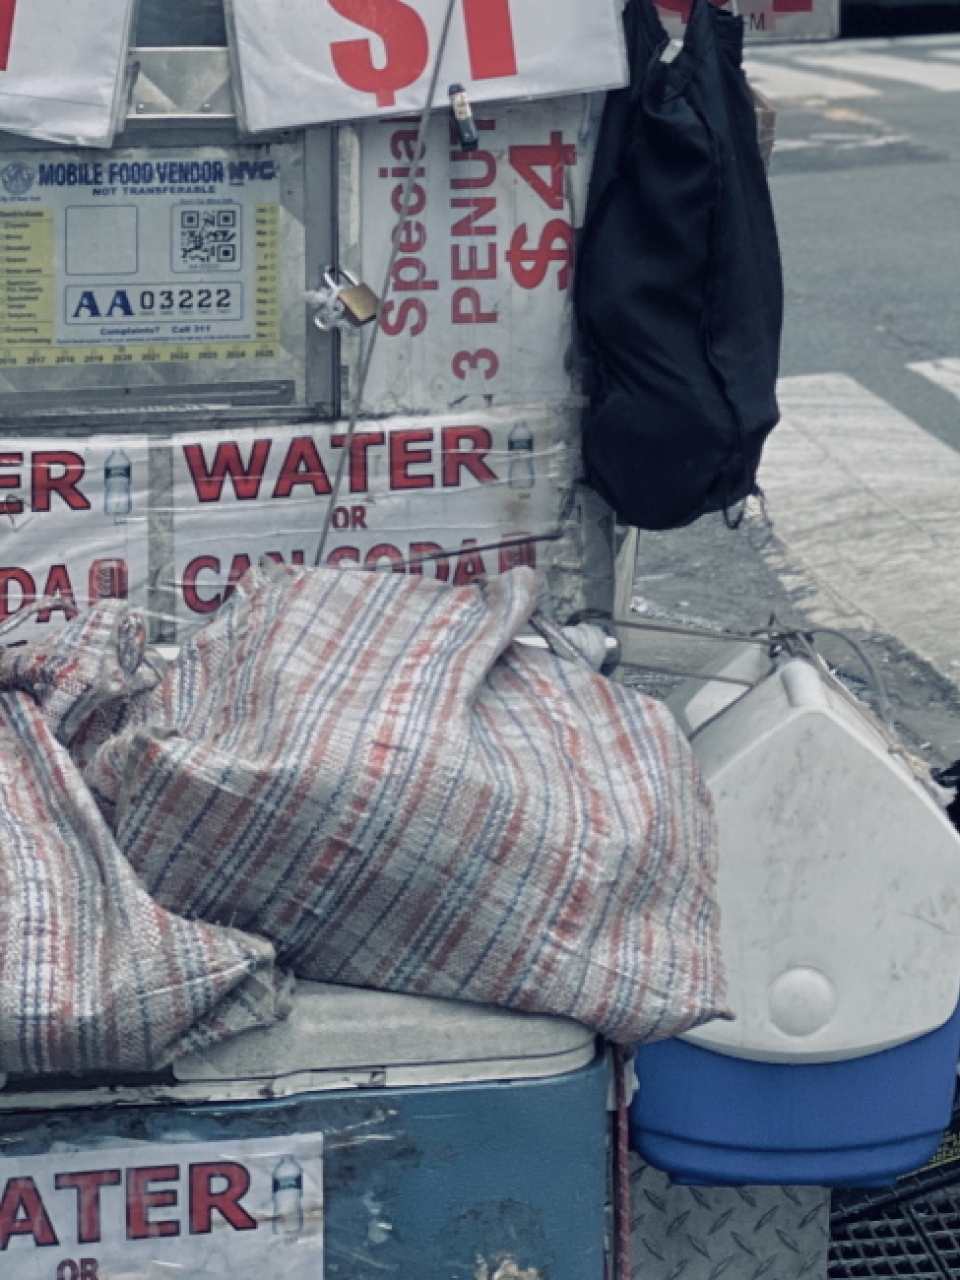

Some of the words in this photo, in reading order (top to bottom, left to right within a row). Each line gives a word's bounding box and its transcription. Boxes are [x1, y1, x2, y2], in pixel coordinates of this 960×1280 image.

[38, 162, 103, 186] MOBILE
[108, 162, 154, 185] FOOD
[155, 161, 224, 184] VENDOR
[379, 115, 440, 337] Special
[505, 131, 577, 291] $4
[72, 289, 135, 318] AA
[139, 288, 231, 311] 03222
[452, 347, 499, 380] 3
[183, 425, 498, 503] WATER
[332, 505, 368, 529] OR
